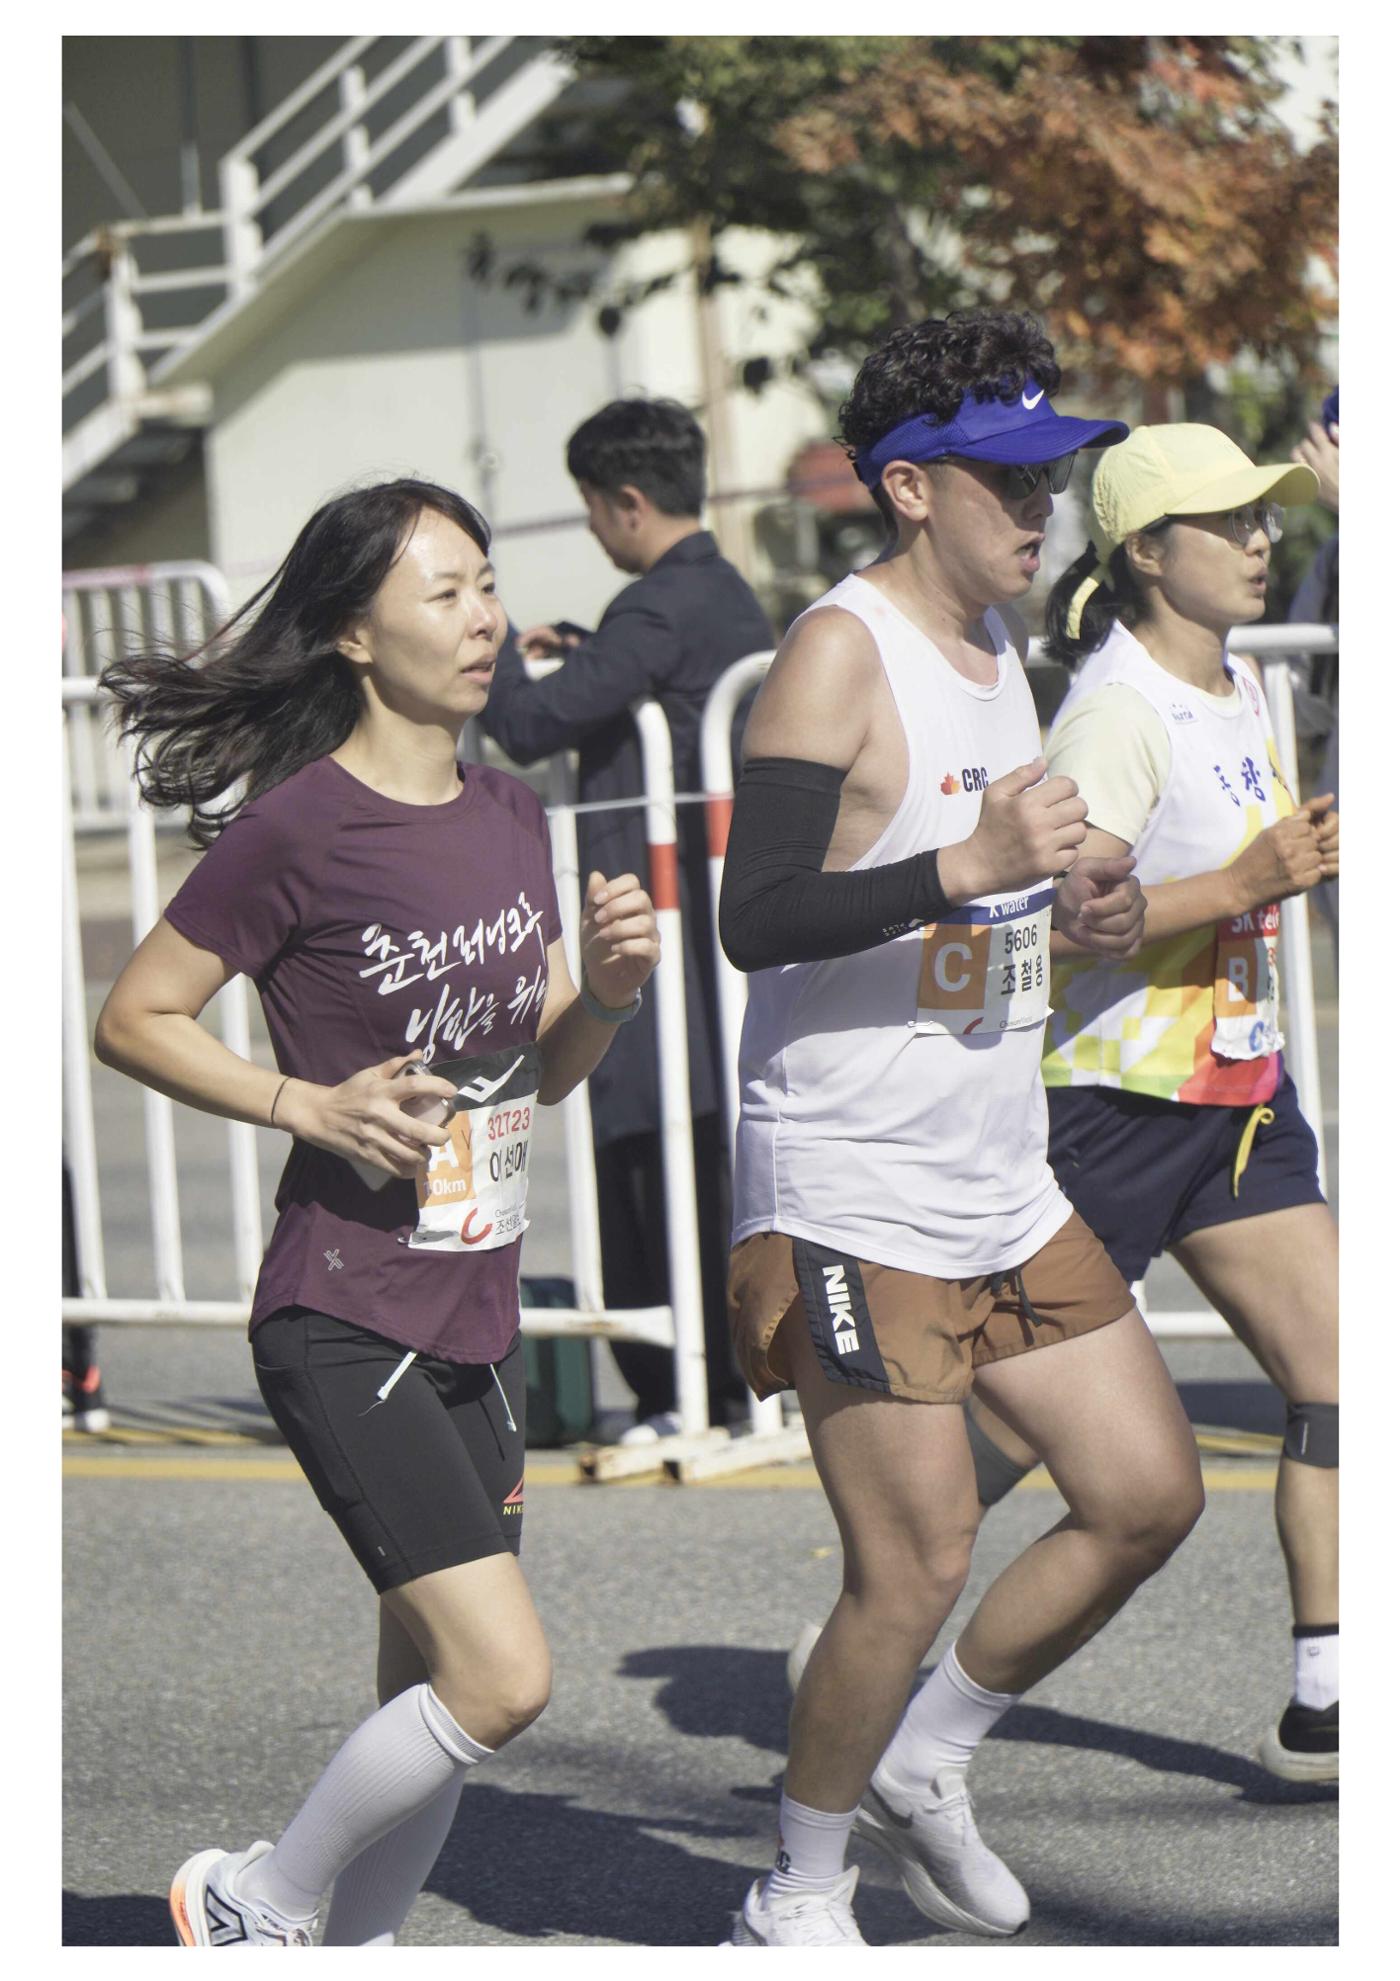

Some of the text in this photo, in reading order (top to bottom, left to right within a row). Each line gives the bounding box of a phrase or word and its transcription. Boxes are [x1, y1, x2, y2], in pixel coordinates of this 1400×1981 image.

[962, 766, 989, 792] CRC
[1001, 896, 1030, 916] water
[1004, 924, 1038, 954] 5606
[934, 942, 973, 992] C
[1228, 957, 1249, 1003] B
[488, 1107, 530, 1140] 32723
[428, 1138, 460, 1172] A
[822, 1264, 860, 1355] NIKE
